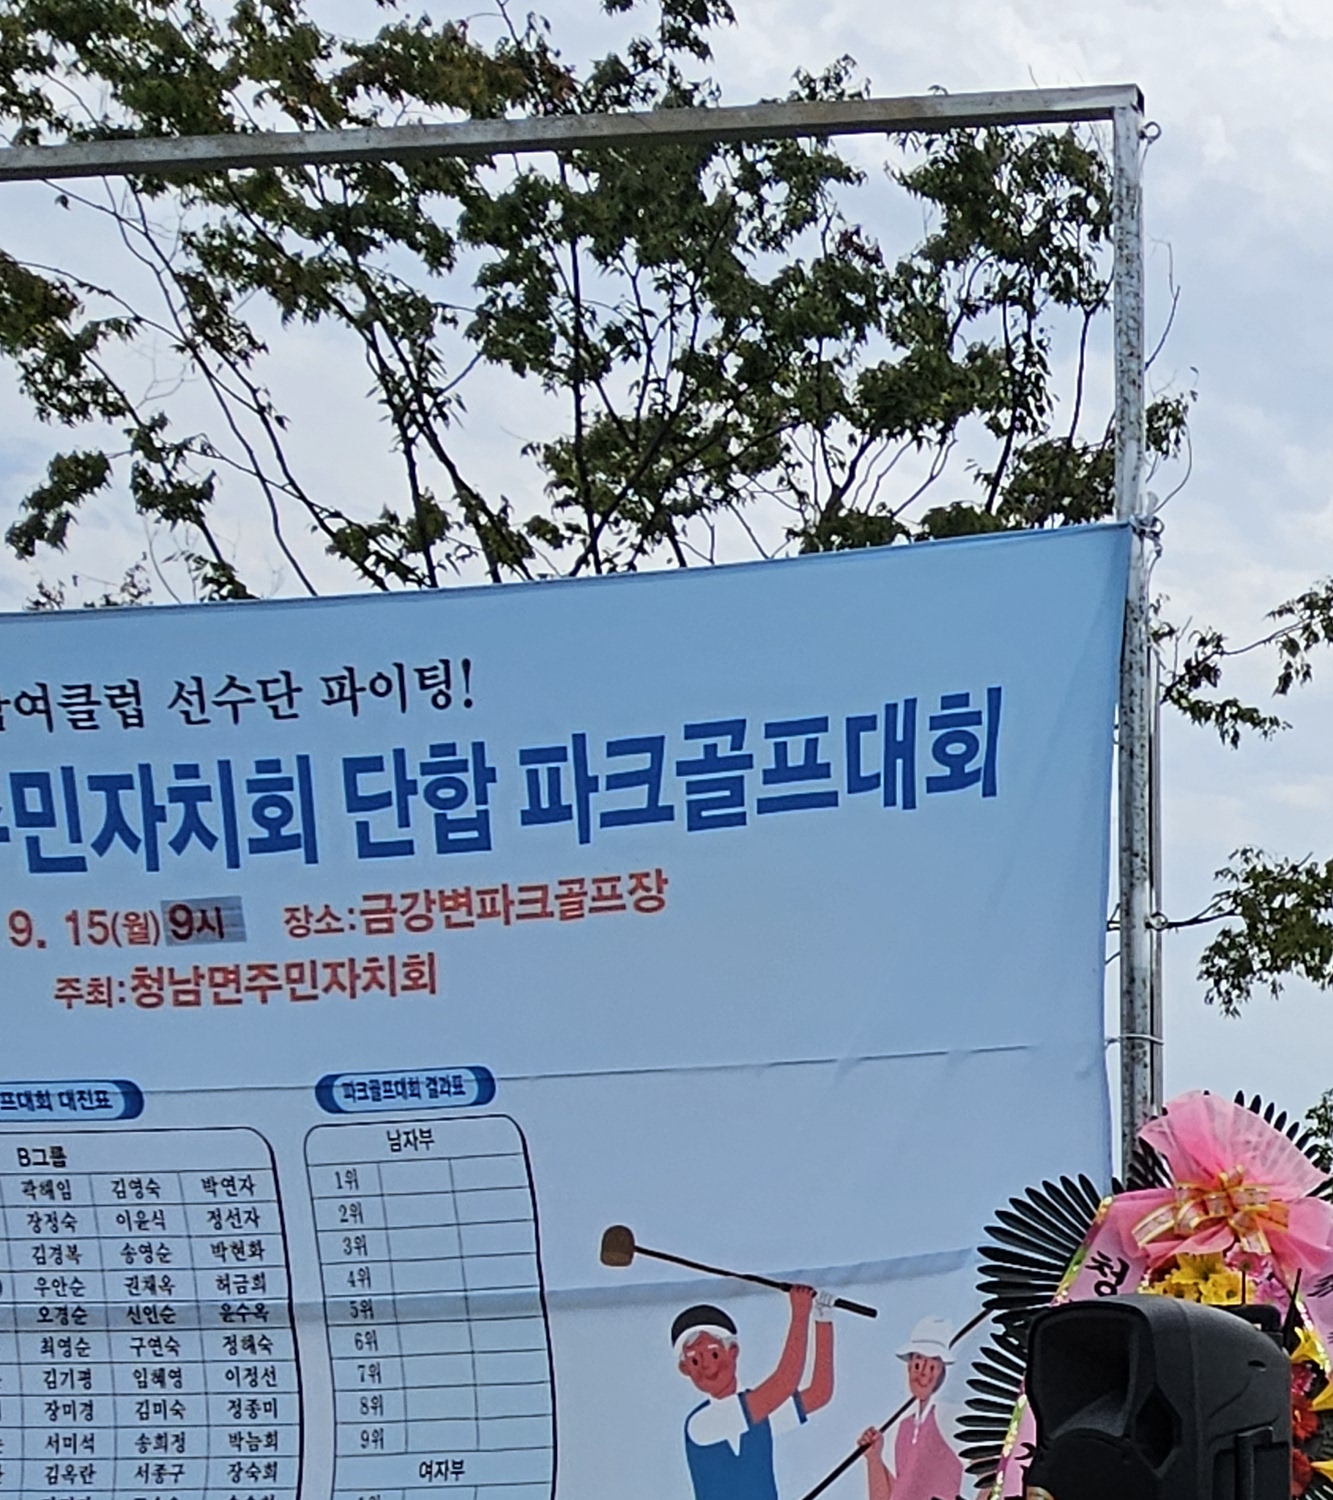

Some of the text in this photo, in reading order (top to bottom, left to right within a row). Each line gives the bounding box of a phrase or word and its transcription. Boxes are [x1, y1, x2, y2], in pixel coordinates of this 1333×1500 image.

[168, 671, 303, 725] 선수단
[320, 659, 472, 716] 파이팅!
[0, 687, 1001, 873] 민자치회 단합 파크골프대회
[9, 869, 668, 948] 9. 15(월) 9시 장소:금강변파크골프장
[55, 952, 436, 1009] 주최:청남면주민자치회
[340, 1074, 468, 1102] 파크골프대회 결과표
[57, 1090, 115, 1110] 대진표
[387, 1129, 434, 1152] 남자부
[17, 1146, 67, 1168] B그룹
[112, 1178, 160, 1199] 김영숙
[201, 1175, 255, 1197] 박연자
[335, 1169, 359, 1190] 1위
[27, 1211, 77, 1233] 장정숙
[208, 1207, 260, 1230] 정선자
[339, 1202, 363, 1223] 2위
[33, 1244, 81, 1265] 김경복
[121, 1243, 171, 1264] 송영순
[343, 1235, 367, 1256] 3위
[344, 1263, 371, 1287] 4위
[34, 1276, 85, 1297] 우안순
[34, 1302, 91, 1325] 오경순
[124, 1302, 176, 1325] 신인순
[216, 1300, 269, 1323] 윤수옥
[347, 1296, 374, 1319] 5위
[41, 1337, 90, 1358] 최영순
[130, 1336, 180, 1357] 구연숙
[355, 1330, 378, 1350] 6위
[225, 1366, 277, 1387] 이정선
[358, 1363, 381, 1383] 7위
[45, 1400, 93, 1421] 장미경
[136, 1399, 185, 1420] 김미숙
[361, 1395, 383, 1415] 8위
[47, 1433, 94, 1454] 서미석
[361, 1428, 383, 1449] 9위
[46, 1464, 96, 1485] 김옥란
[419, 1460, 465, 1482] 여자부
